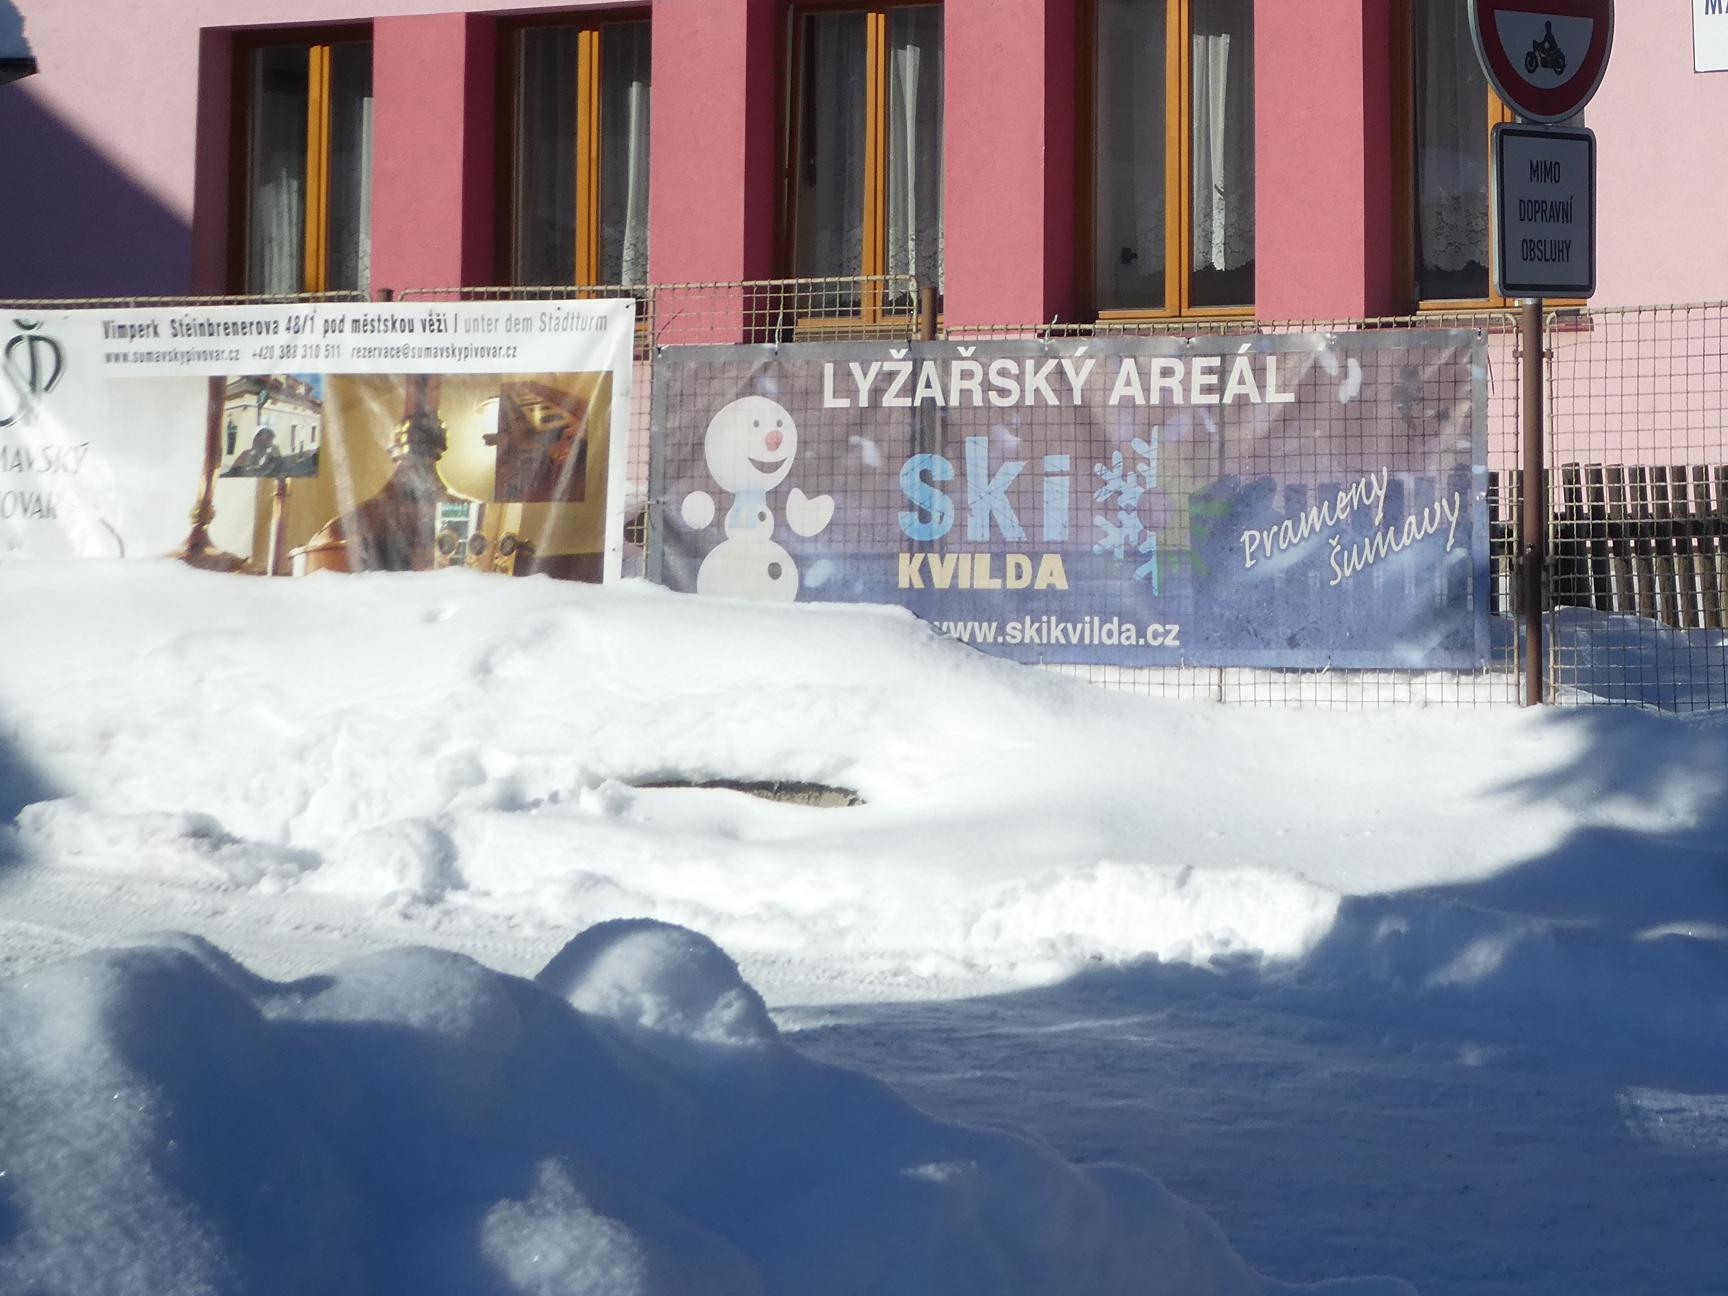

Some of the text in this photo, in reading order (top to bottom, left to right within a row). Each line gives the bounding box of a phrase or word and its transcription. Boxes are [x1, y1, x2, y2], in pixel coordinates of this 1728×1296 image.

[1529, 159, 1561, 184] MIMO
[1519, 195, 1574, 224] DOPRAVNÍ
[1521, 238, 1572, 263] OBSLUHY
[102, 319, 161, 343] Vimperk
[322, 313, 345, 339] pod
[420, 311, 449, 334] věží
[464, 312, 500, 333] unter
[505, 311, 534, 333] dem
[539, 310, 608, 332] Stadtturm
[104, 347, 241, 366] www.sumavskypivovar.cz
[251, 345, 275, 361] +420
[324, 343, 342, 360] 511
[351, 343, 518, 363] rezervace@sumavskypivovar.cz
[823, 342, 1297, 409] LYŽAŘSKÝ AREÁL
[0, 441, 90, 474] AVSKÝ
[0, 489, 58, 520] OVAR
[1240, 466, 1389, 568] Prameny
[1329, 491, 1462, 586] Šumavy
[897, 552, 1069, 590] KVILDA
